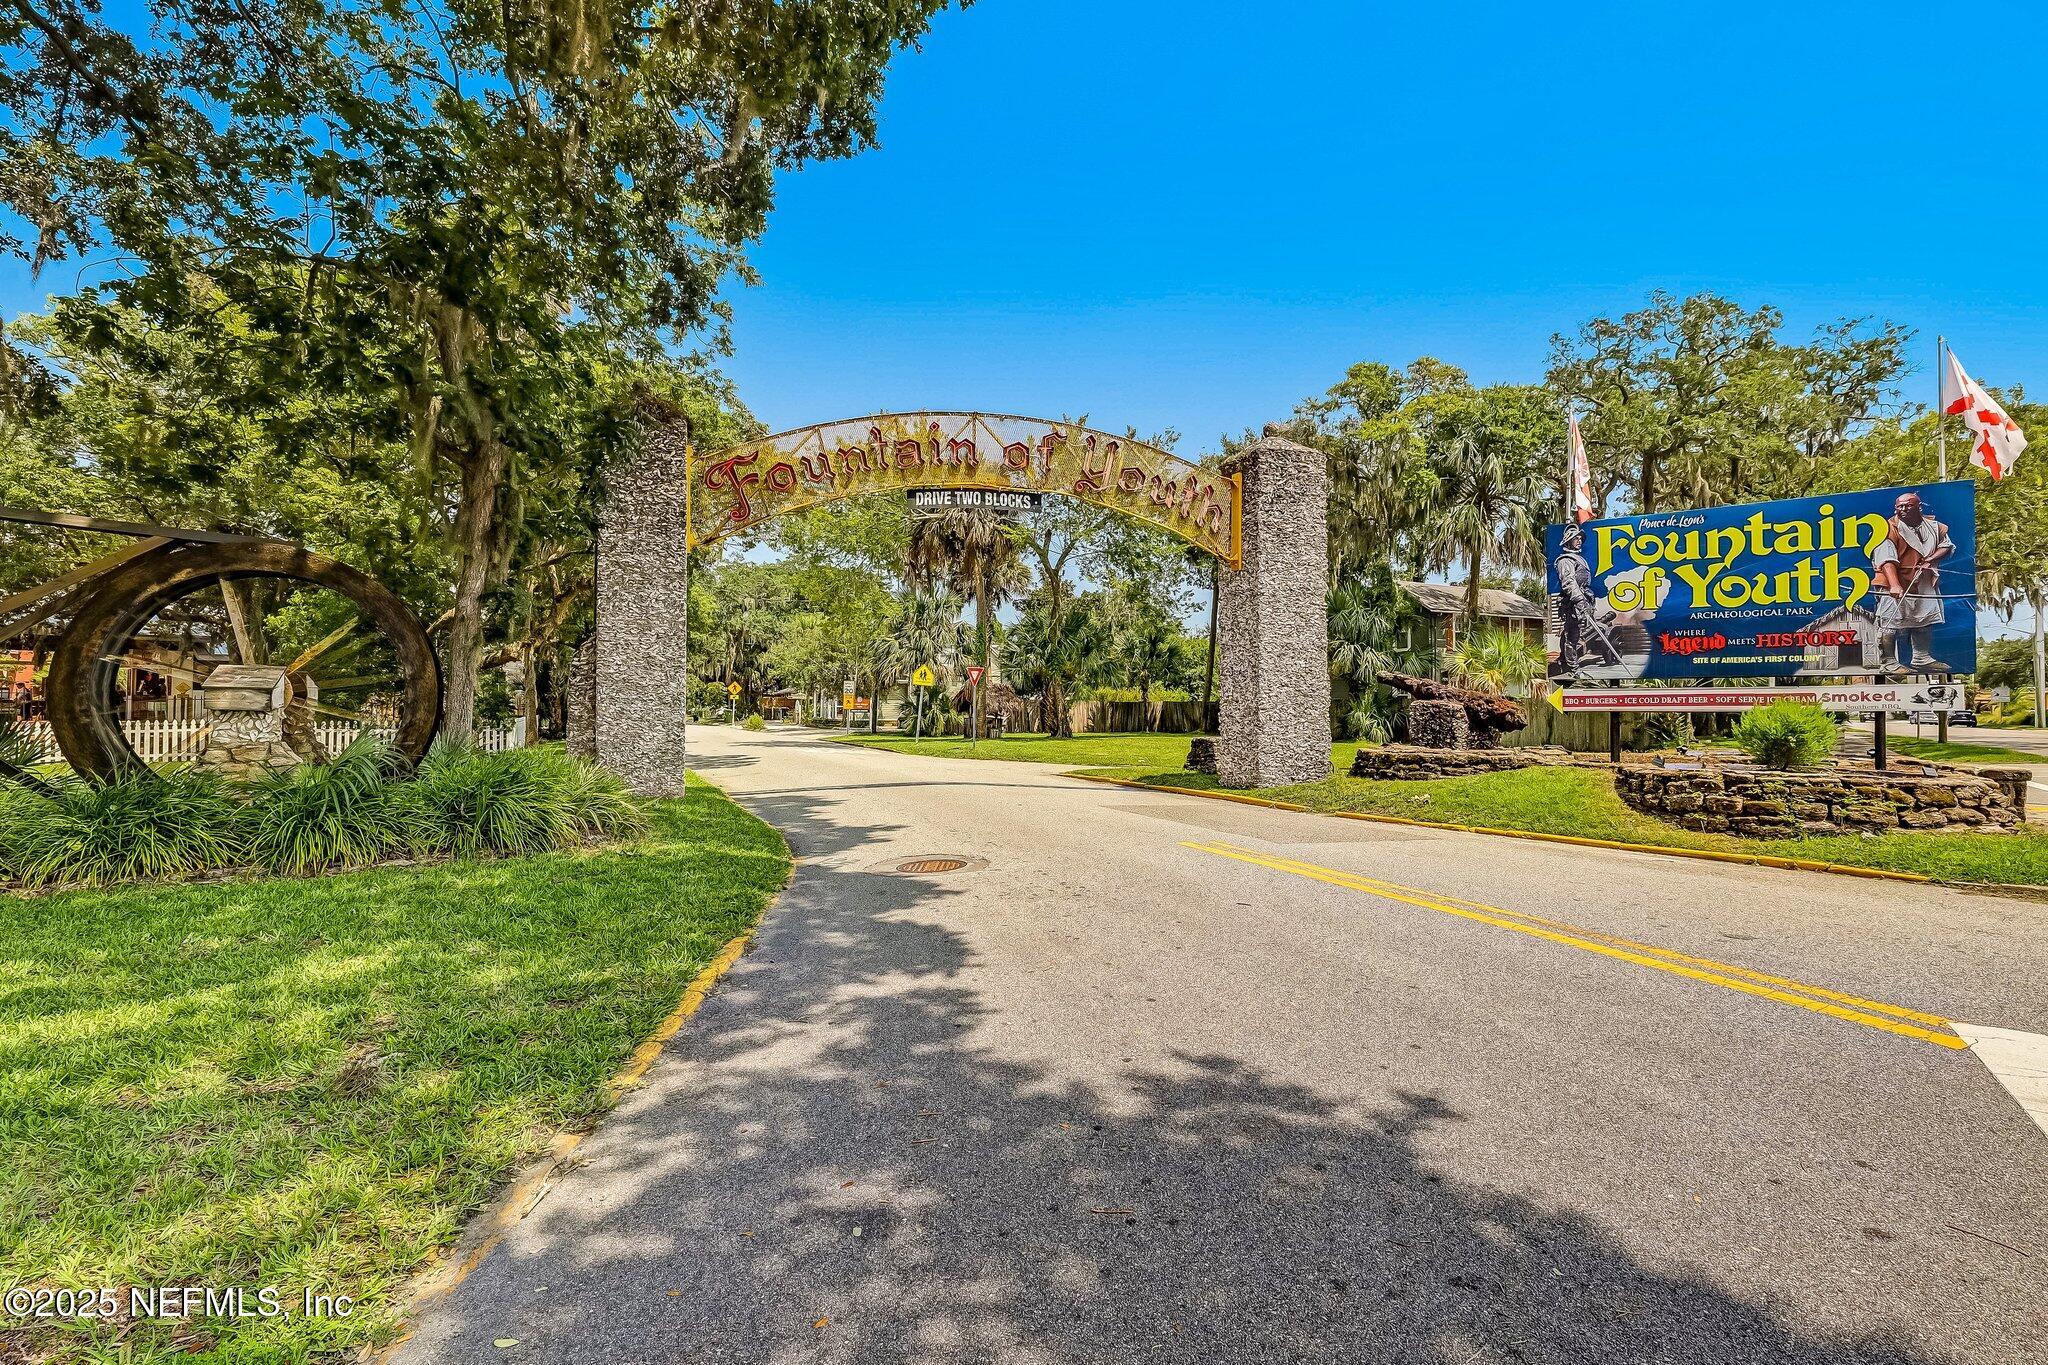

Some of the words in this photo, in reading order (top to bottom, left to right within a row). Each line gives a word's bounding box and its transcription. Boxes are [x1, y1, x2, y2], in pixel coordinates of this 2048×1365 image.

[704, 421, 979, 522] Fountain
[1003, 431, 1067, 471] of
[1074, 434, 1222, 532] Youth
[915, 491, 951, 506] DRIVE
[954, 491, 982, 506] TWO
[985, 492, 1031, 509] BLOCKS
[1638, 518, 1666, 531] Ponce
[1592, 504, 1890, 577] Fountain
[1607, 566, 1666, 612] of
[1672, 552, 1871, 612] Youth
[1690, 609, 1783, 620] ARCHAEOLOGICAL
[1786, 607, 1814, 615] PARK
[1728, 638, 1756, 646] MEETS
